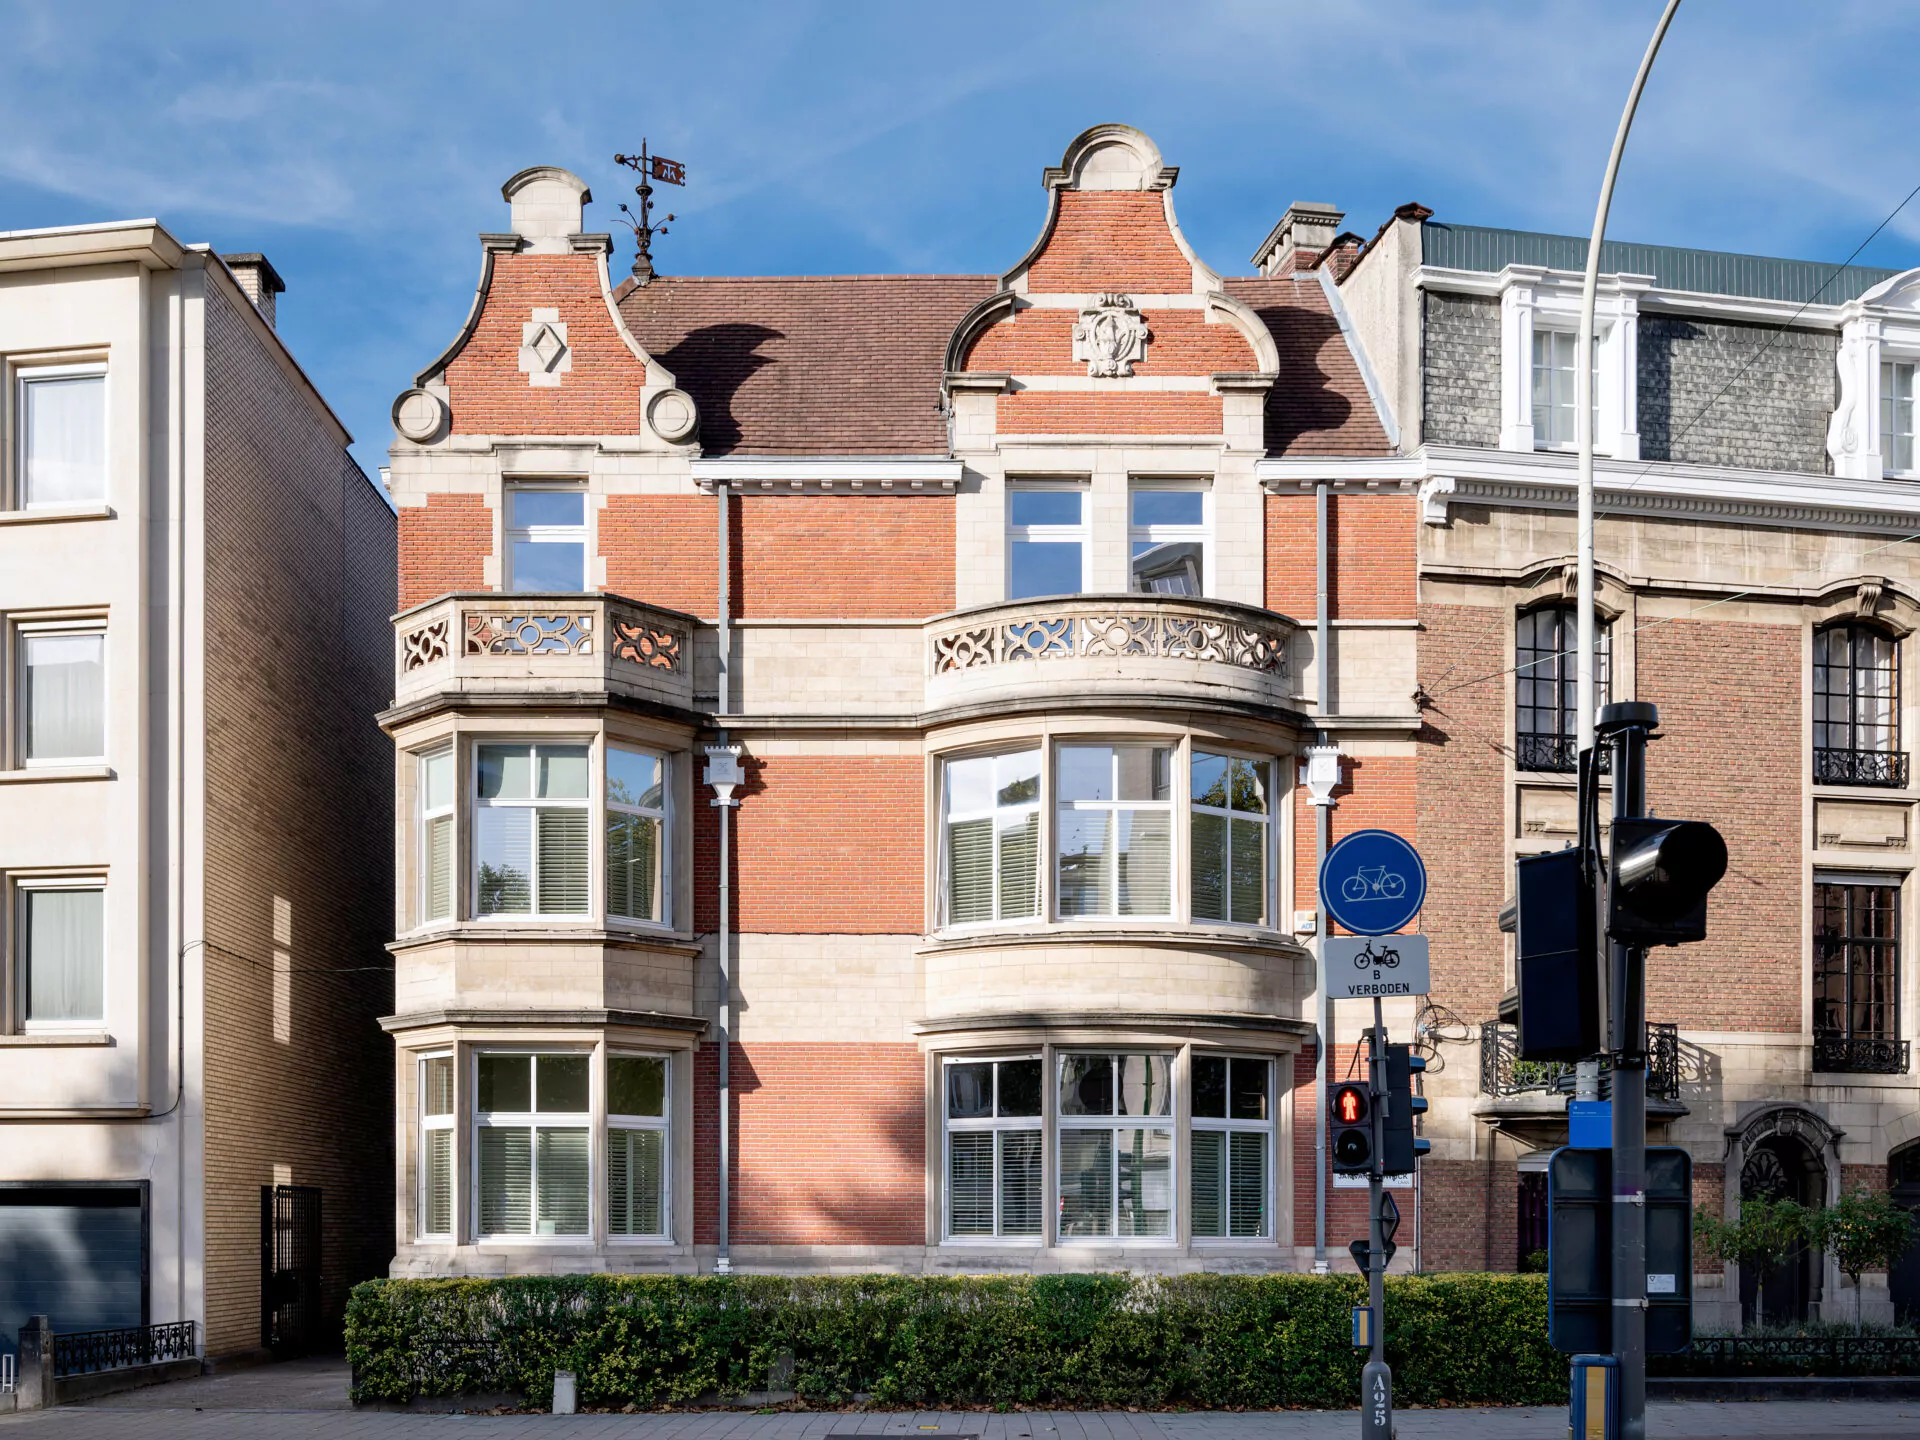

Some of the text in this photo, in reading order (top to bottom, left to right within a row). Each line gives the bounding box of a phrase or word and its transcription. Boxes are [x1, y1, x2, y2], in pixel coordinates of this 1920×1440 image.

[1301, 922, 1314, 930] ADT
[1373, 970, 1381, 980] B
[1348, 983, 1410, 995] VERBODEN
